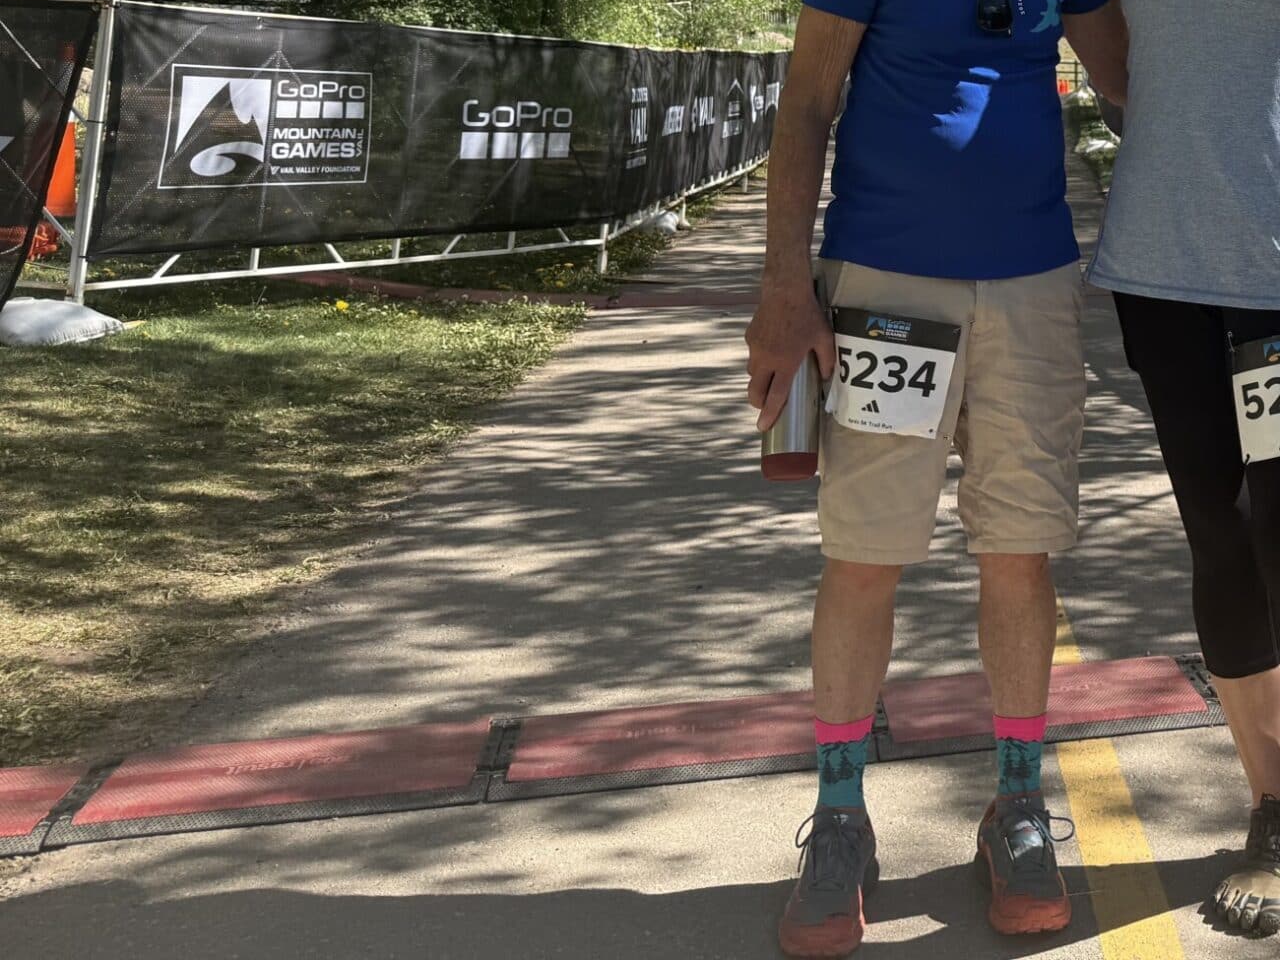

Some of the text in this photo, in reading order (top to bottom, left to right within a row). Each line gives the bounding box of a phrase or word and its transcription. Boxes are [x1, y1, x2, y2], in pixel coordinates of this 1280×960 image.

[277, 80, 365, 99] GoPro
[462, 99, 573, 128] GoPro
[273, 128, 356, 140] MOUNTAIN
[356, 128, 365, 157] VAIL
[271, 142, 356, 159] GAMES
[295, 166, 320, 174] VALLEY
[838, 346, 937, 398] 5234
